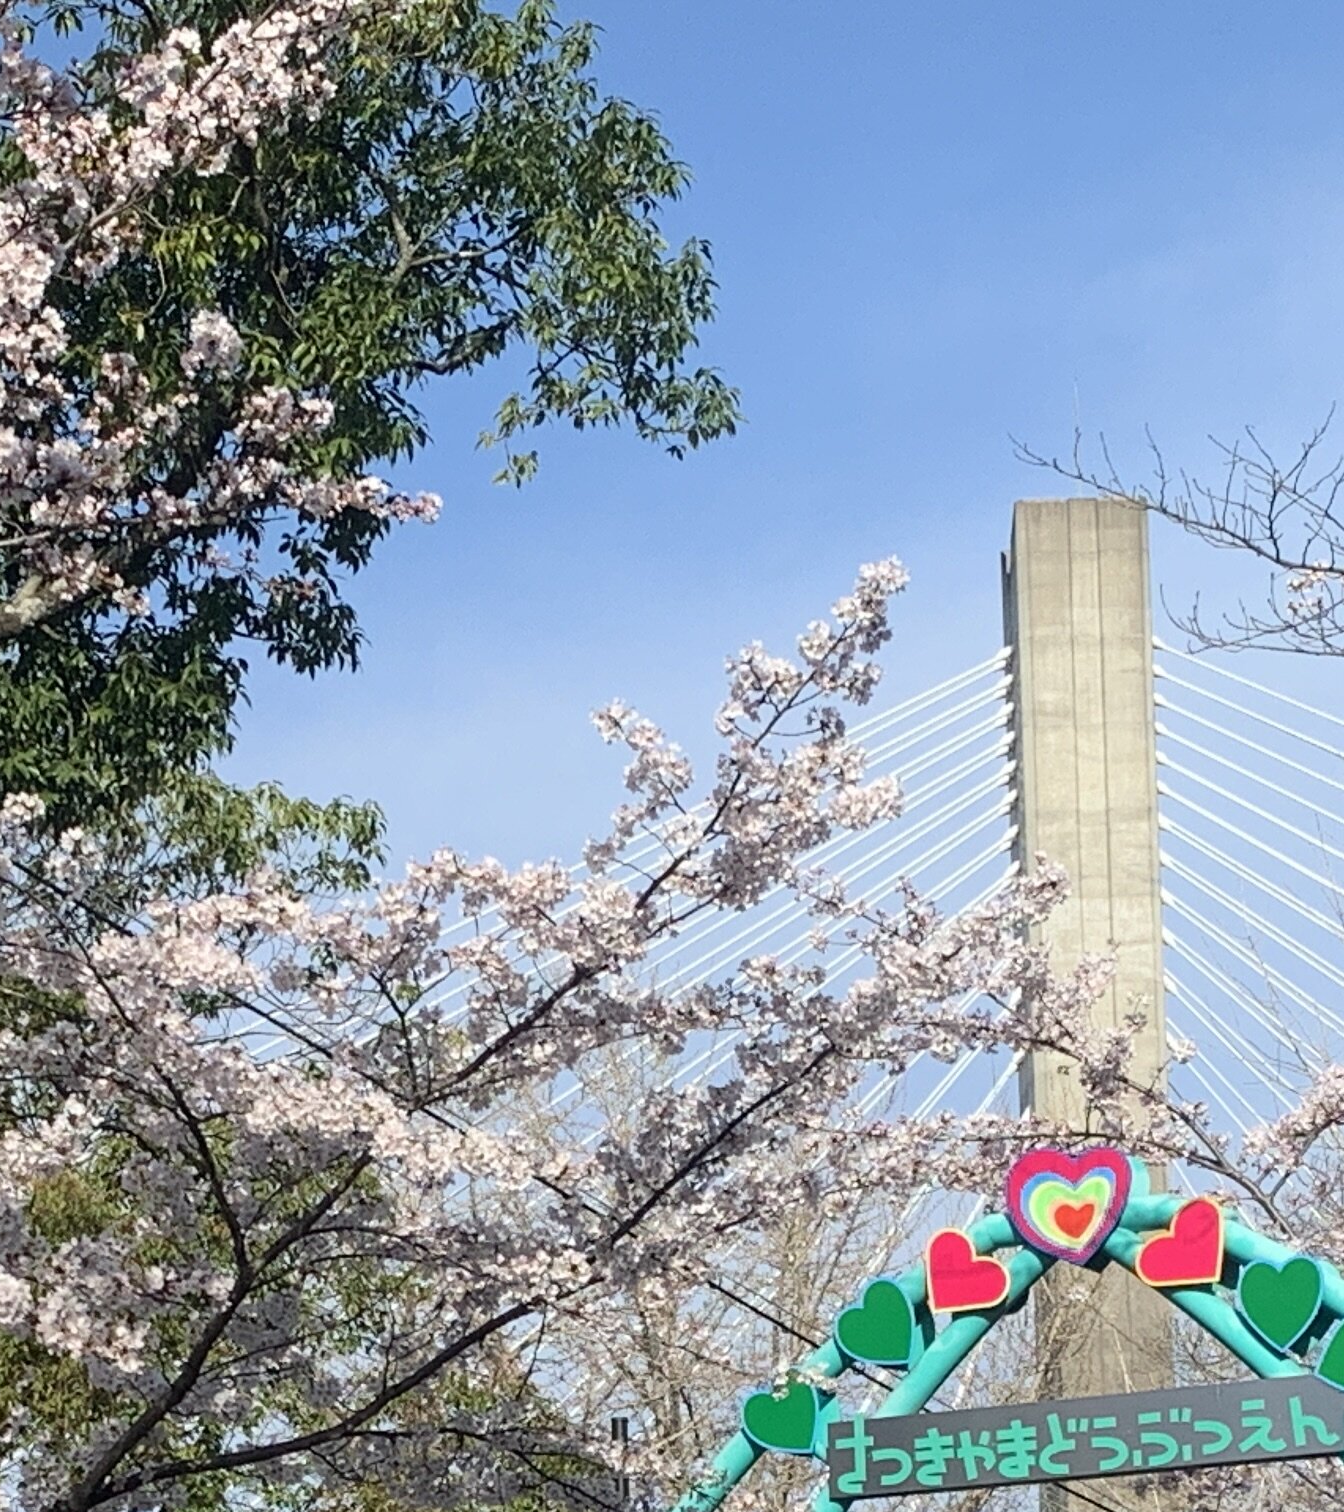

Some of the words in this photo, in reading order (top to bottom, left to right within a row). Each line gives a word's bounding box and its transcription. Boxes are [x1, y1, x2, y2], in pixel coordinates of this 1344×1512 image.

[836, 1396, 1341, 1495] さつきやまどうぶつえん
